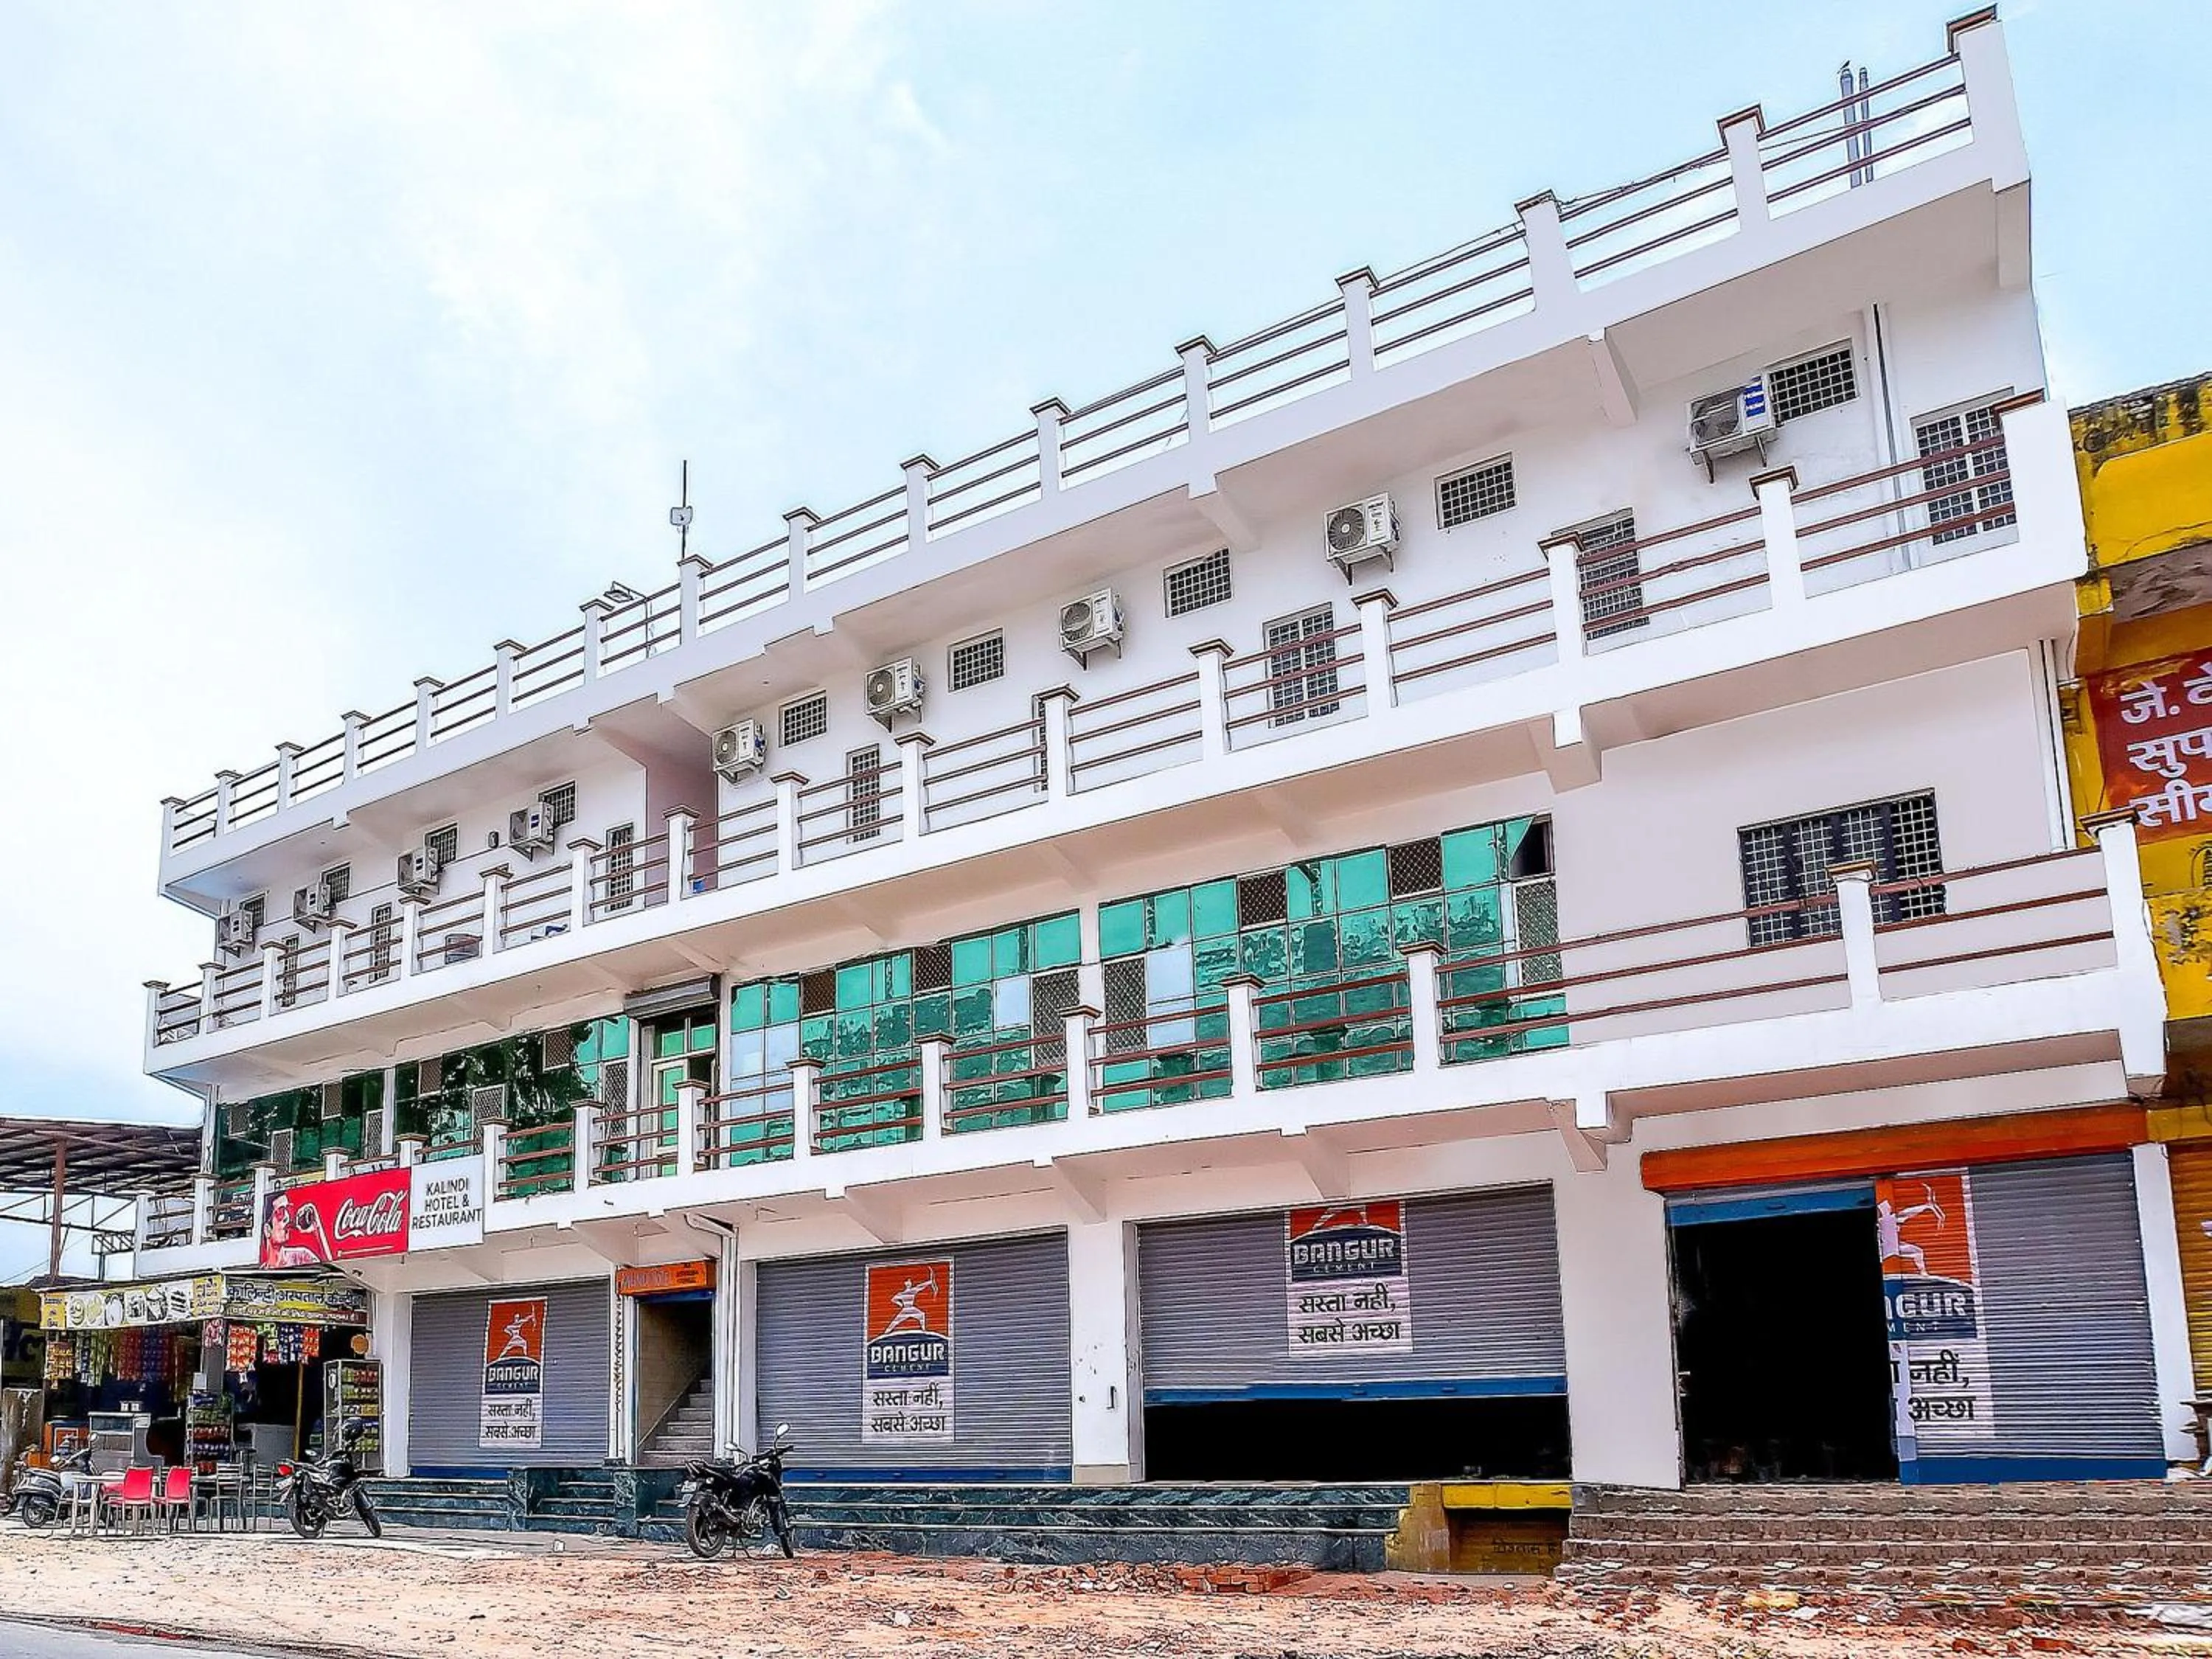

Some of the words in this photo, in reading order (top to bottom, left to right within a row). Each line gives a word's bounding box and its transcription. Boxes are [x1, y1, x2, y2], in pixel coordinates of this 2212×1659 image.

[2126, 726, 2212, 779] सुप
[425, 1178, 469, 1197] KALINDI
[425, 1194, 460, 1210] HOTEL
[462, 1194, 470, 1208] &
[411, 1208, 482, 1231] RESTAURANT
[1293, 1239, 1395, 1265] BANGUR
[1299, 1293, 1346, 1313] सस्ता
[1298, 1317, 1346, 1343] सबसे
[1352, 1322, 1402, 1342] अच्छा
[871, 1343, 945, 1363] BANGUR
[487, 1366, 539, 1382] BANGUR
[872, 1390, 909, 1406] सस्ता
[1907, 1396, 1977, 1421] अच्छा
[871, 1411, 908, 1433] सबसे
[909, 1415, 947, 1432] अच्छा
